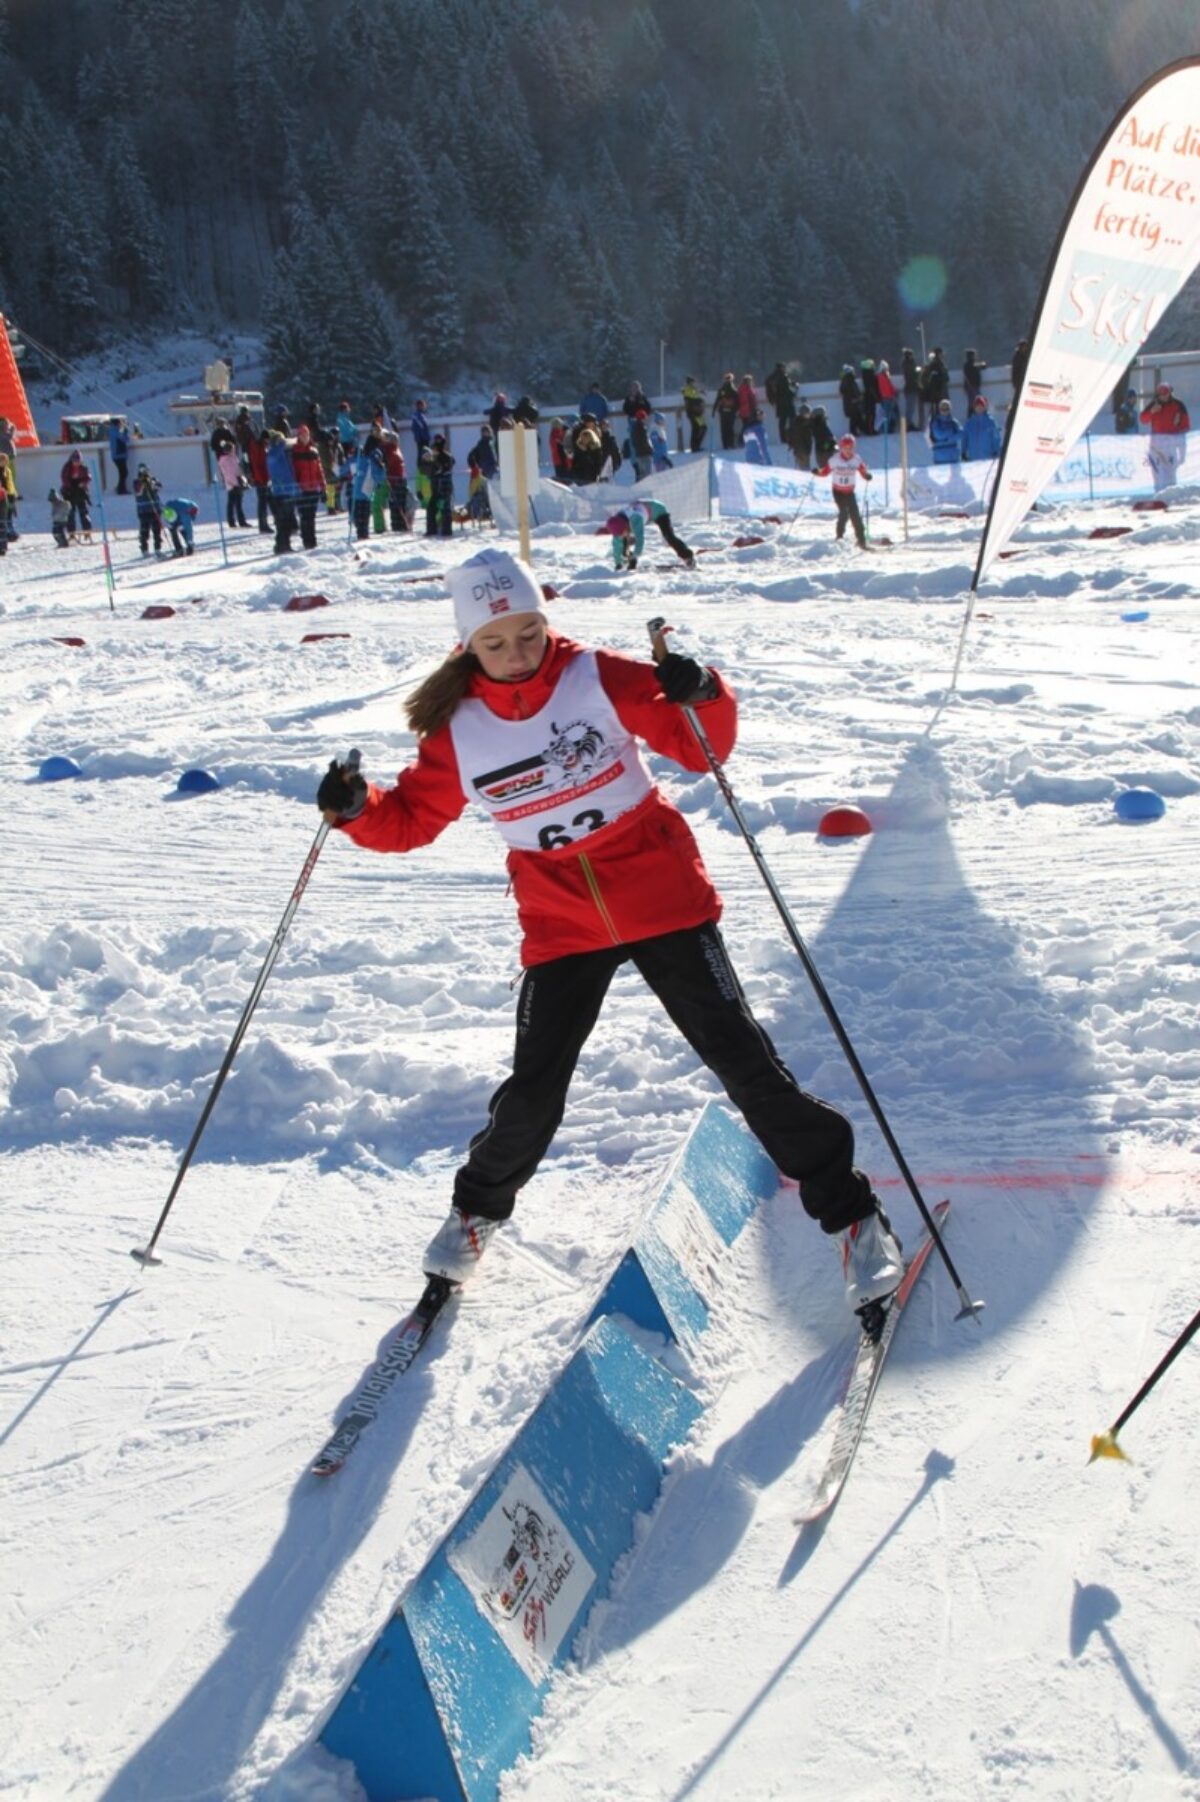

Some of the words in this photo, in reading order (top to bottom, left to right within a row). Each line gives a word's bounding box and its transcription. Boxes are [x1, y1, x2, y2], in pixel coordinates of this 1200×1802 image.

[1117, 116, 1170, 153] Auf
[1106, 158, 1196, 205] Plätze,
[472, 569, 515, 602] DNB
[350, 1335, 421, 1420] ROSSIGNOL
